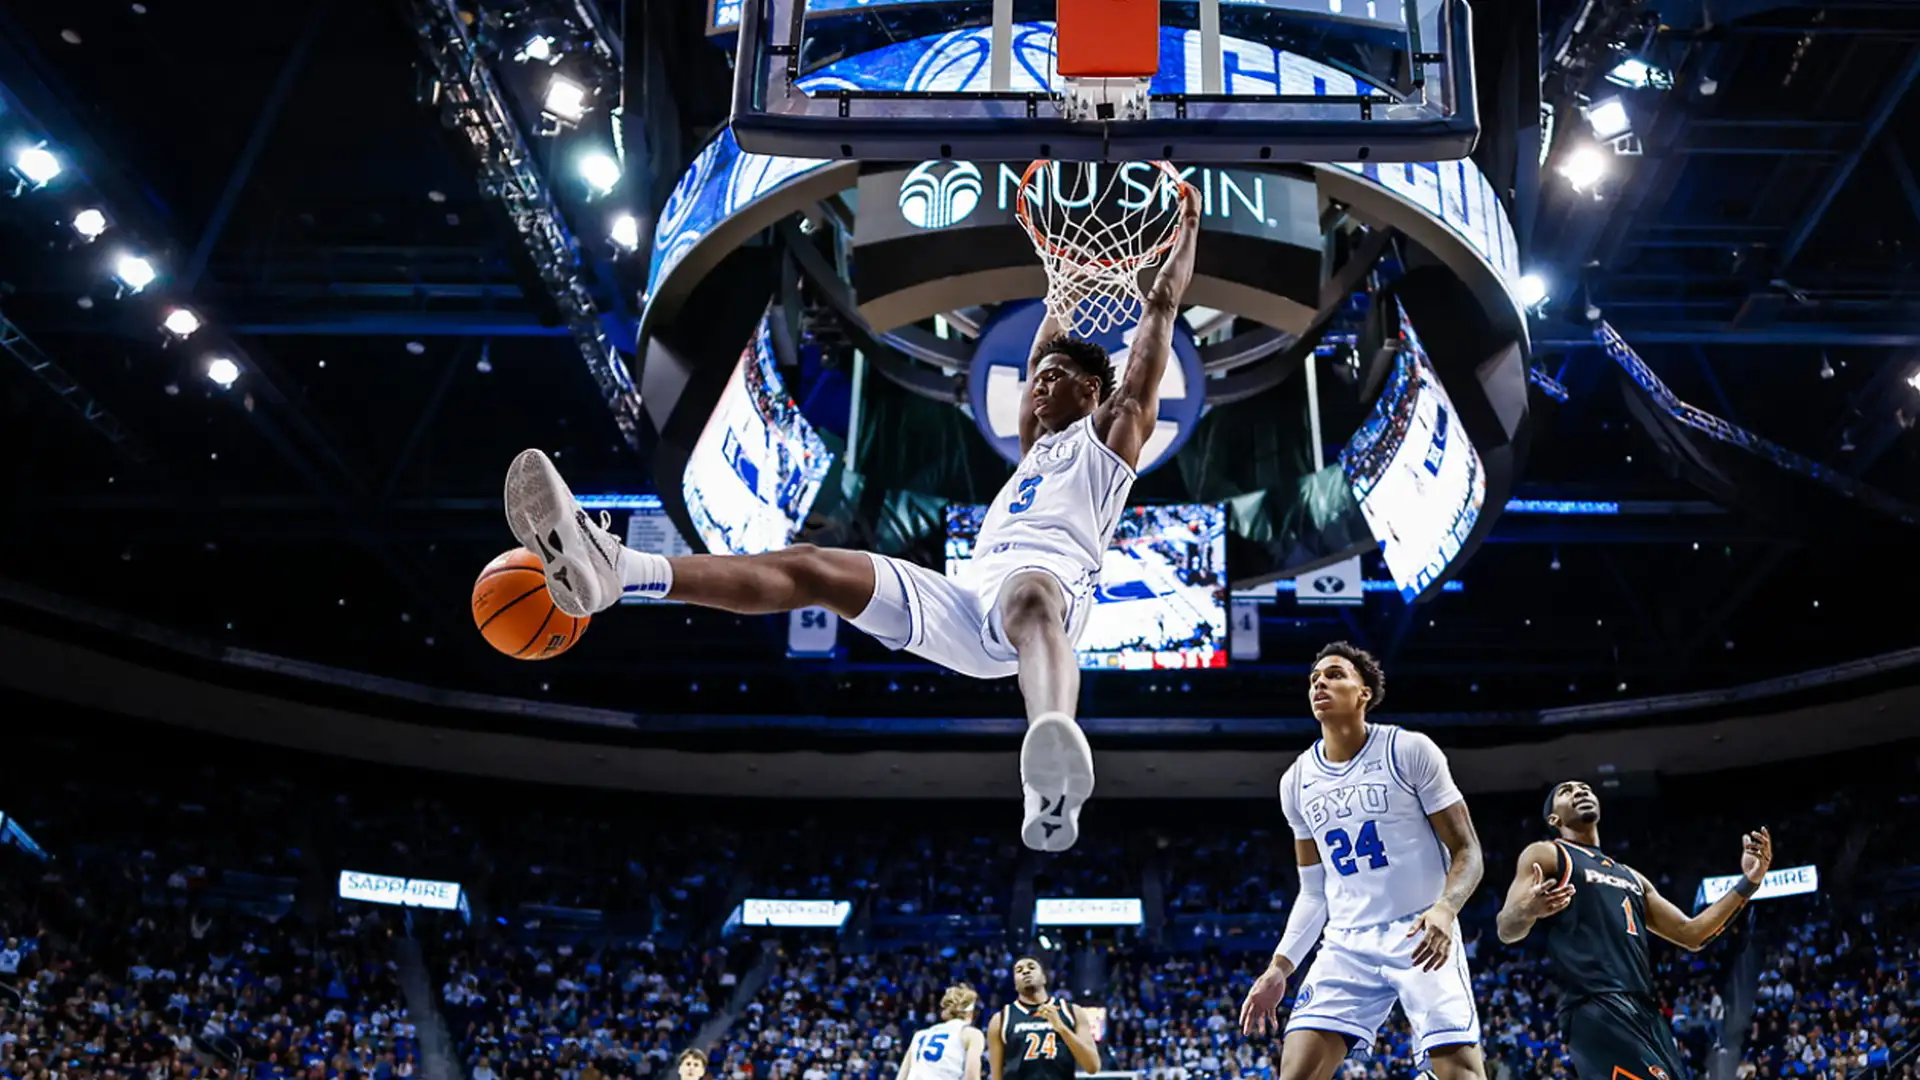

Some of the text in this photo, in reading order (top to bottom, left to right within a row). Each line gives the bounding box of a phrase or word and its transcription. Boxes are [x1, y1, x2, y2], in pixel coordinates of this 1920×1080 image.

[998, 160, 1265, 224] NU SKIN
[1009, 475, 1044, 515] 3
[801, 610, 827, 629] 54
[1305, 783, 1389, 834] BYU
[1324, 819, 1389, 877] 24
[347, 874, 450, 899] SAPPHIRE
[1711, 868, 1811, 893] SAHIRE
[1621, 896, 1639, 936] 1
[916, 1033, 949, 1063] 15
[1023, 1032, 1058, 1061] 24
